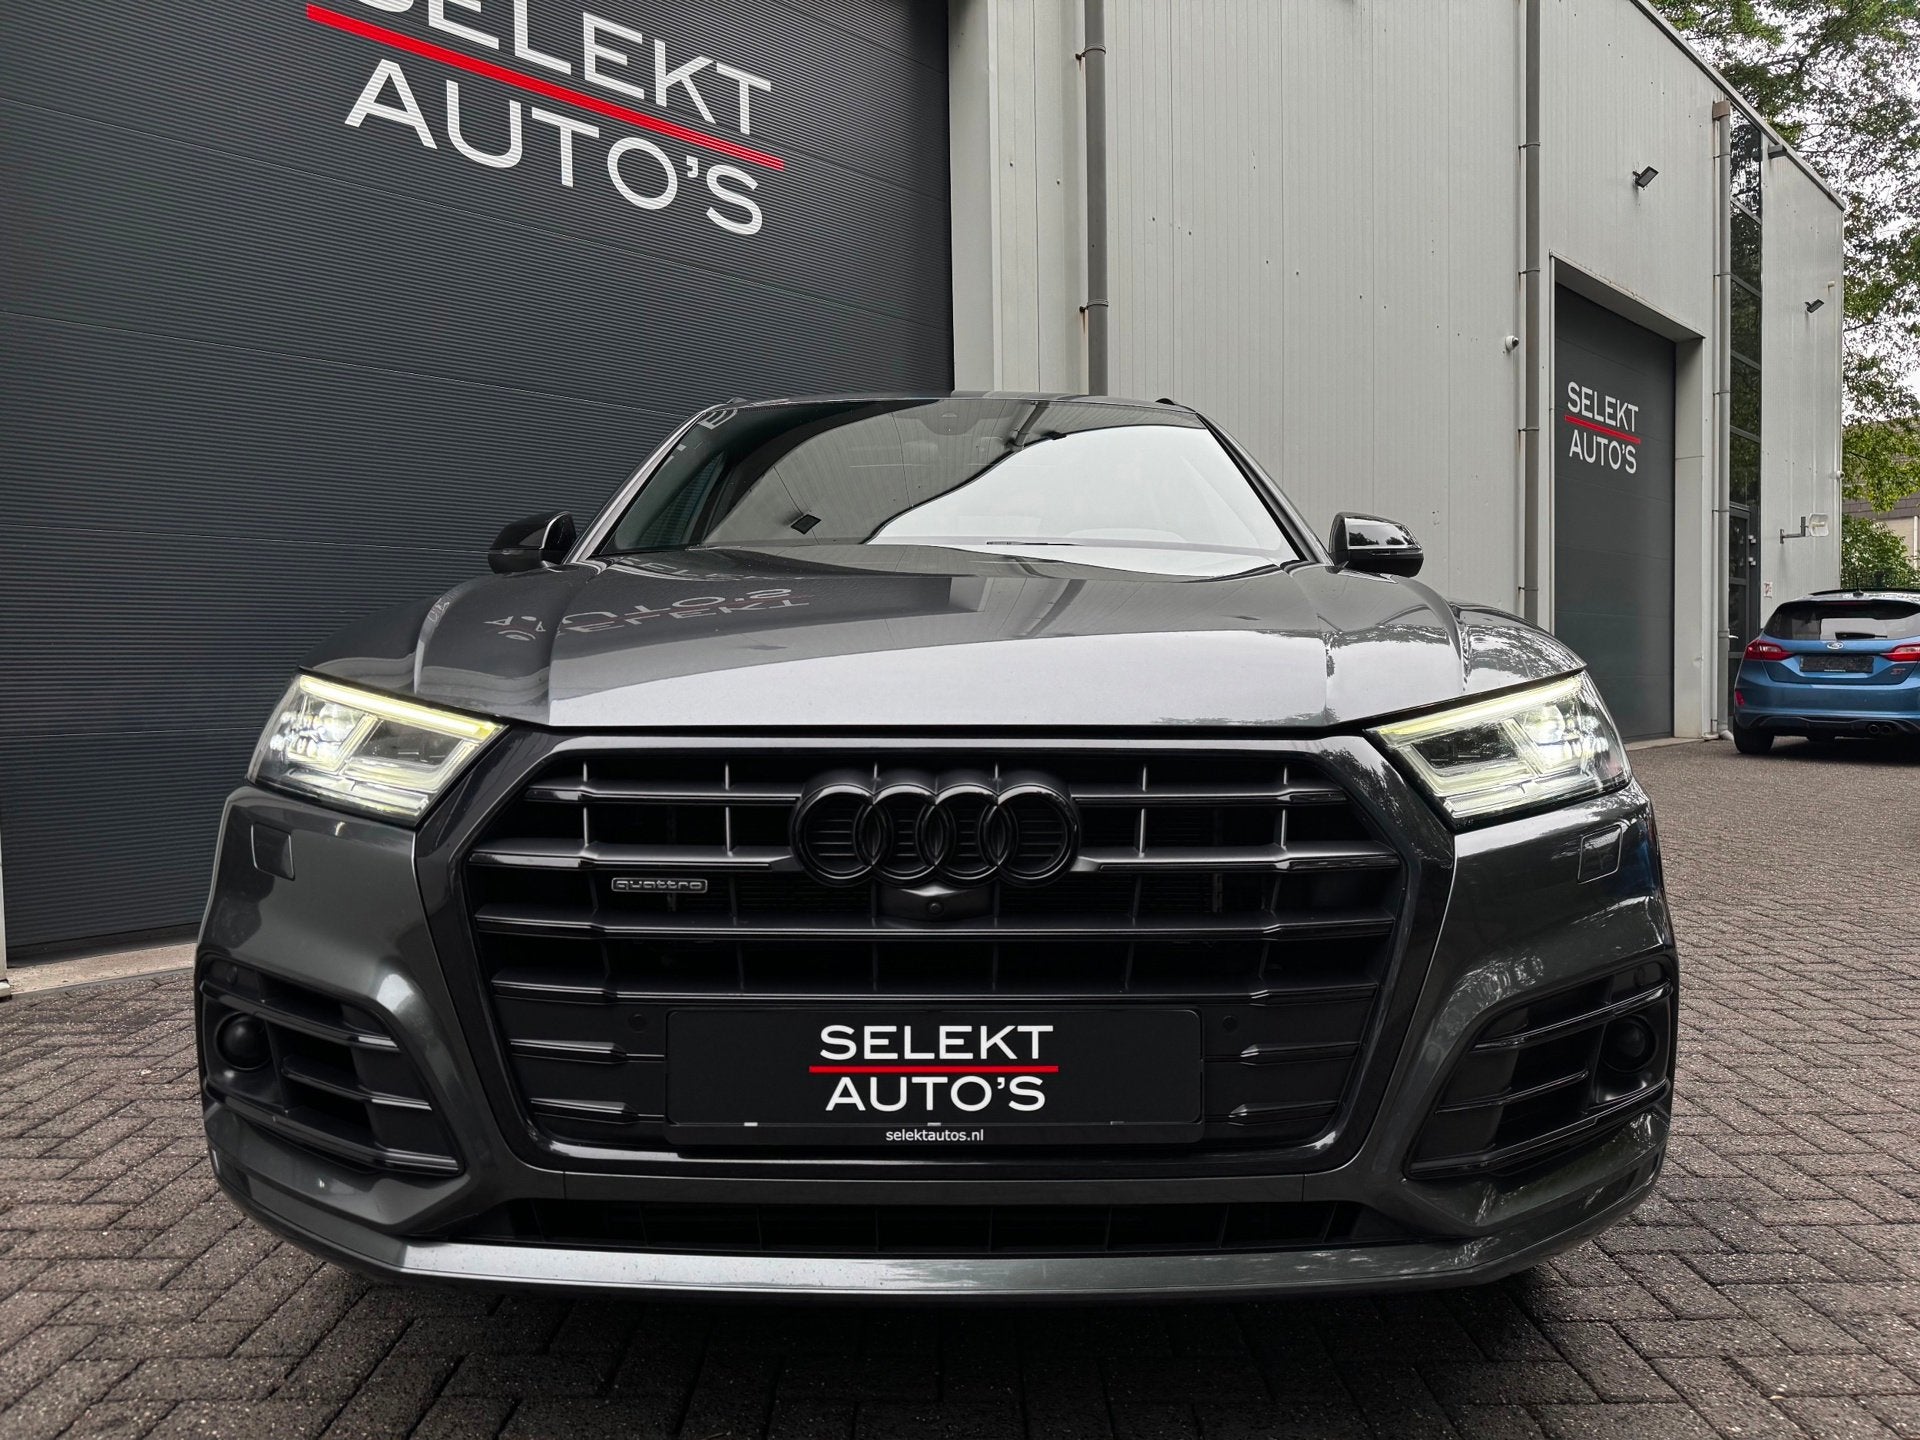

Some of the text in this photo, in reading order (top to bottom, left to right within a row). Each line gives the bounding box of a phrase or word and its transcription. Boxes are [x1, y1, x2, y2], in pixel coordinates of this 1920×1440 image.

[357, 0, 772, 135] ELEKT
[344, 58, 763, 235] AUTO'S
[1567, 381, 1639, 432] SELEKT
[1569, 429, 1636, 474] AUTO'S
[615, 880, 703, 890] quattro
[820, 1025, 1053, 1060] SELEKT
[825, 1075, 1046, 1112] AUTO'S
[885, 1128, 984, 1142] selektautos.nl
